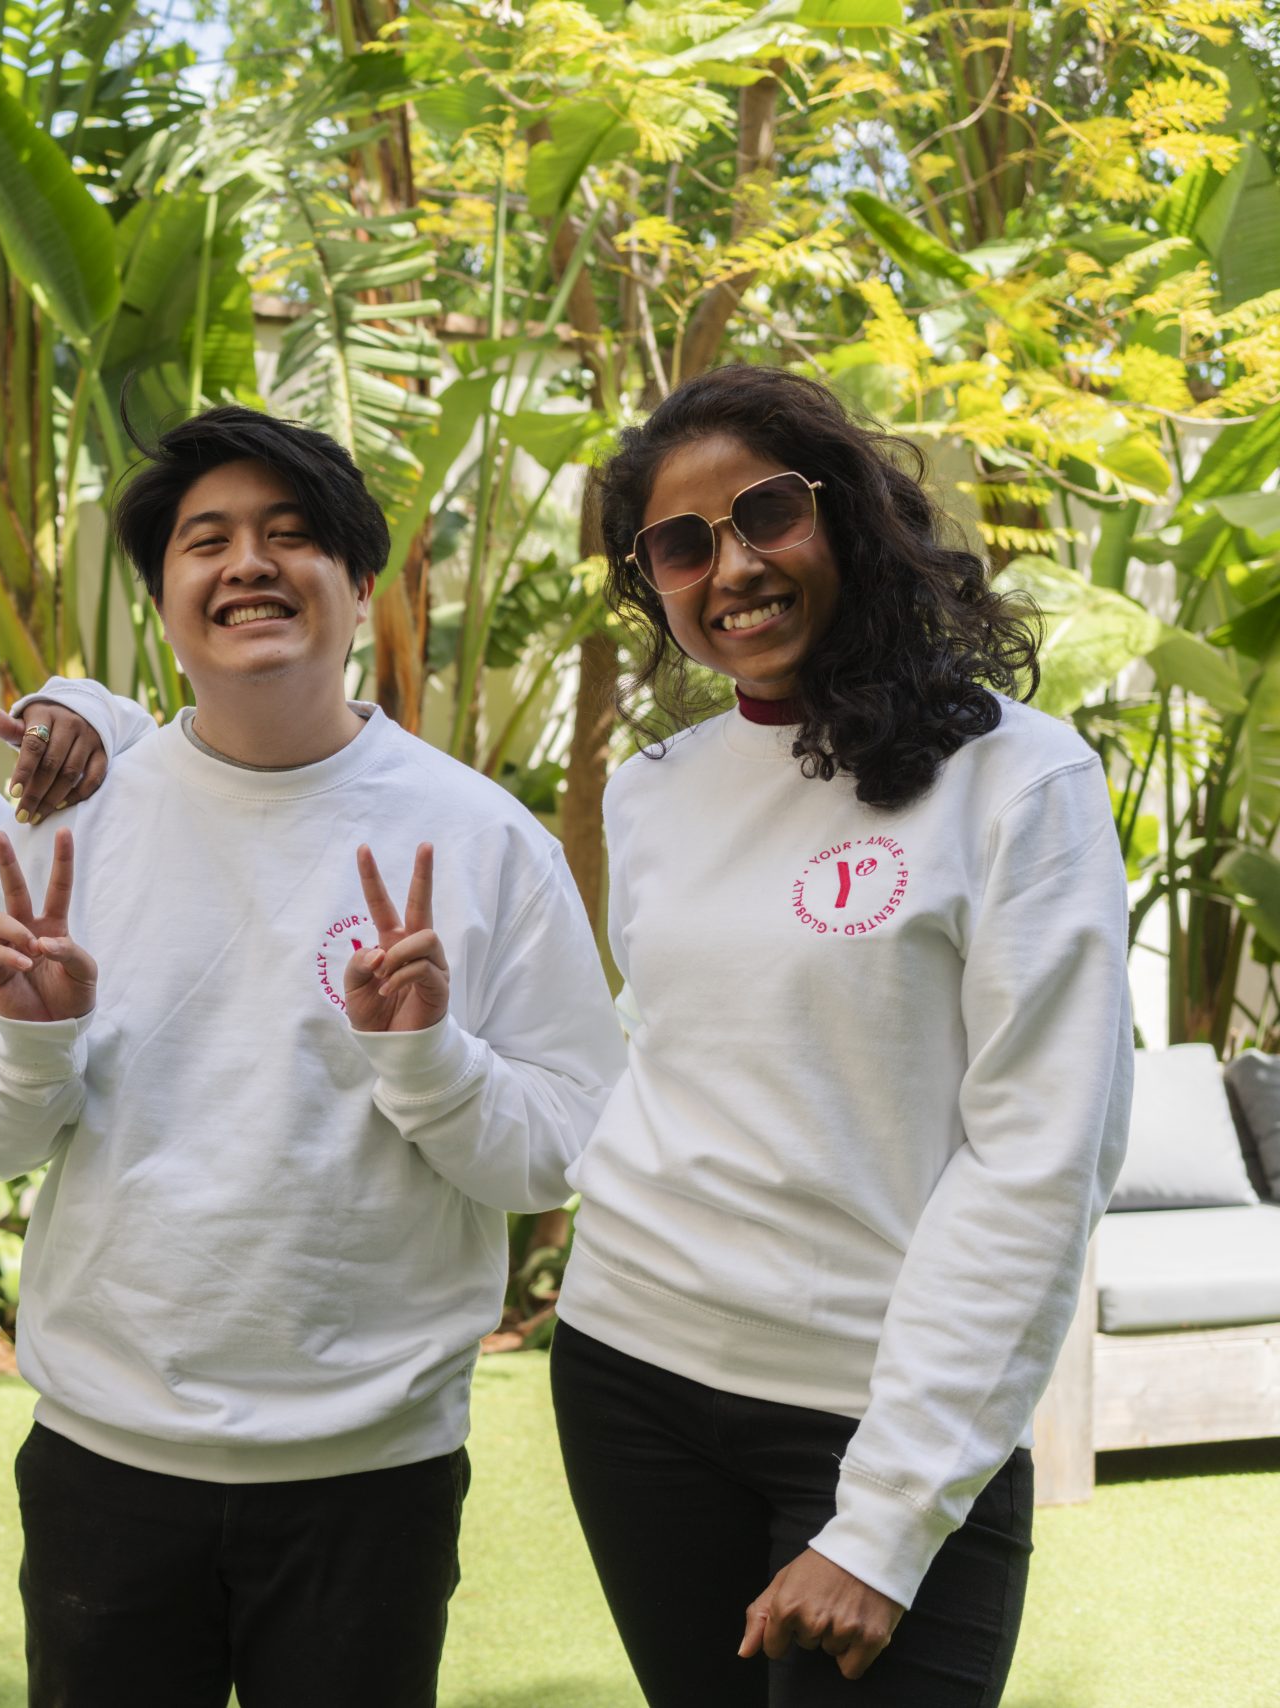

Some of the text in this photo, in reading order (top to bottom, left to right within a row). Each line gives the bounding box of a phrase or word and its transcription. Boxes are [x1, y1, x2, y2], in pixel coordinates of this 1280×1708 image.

[792, 836, 909, 936] YOUR ANGLE PRESENTED GLOBALLY
[317, 915, 361, 1013] YOUR LOBALLY
